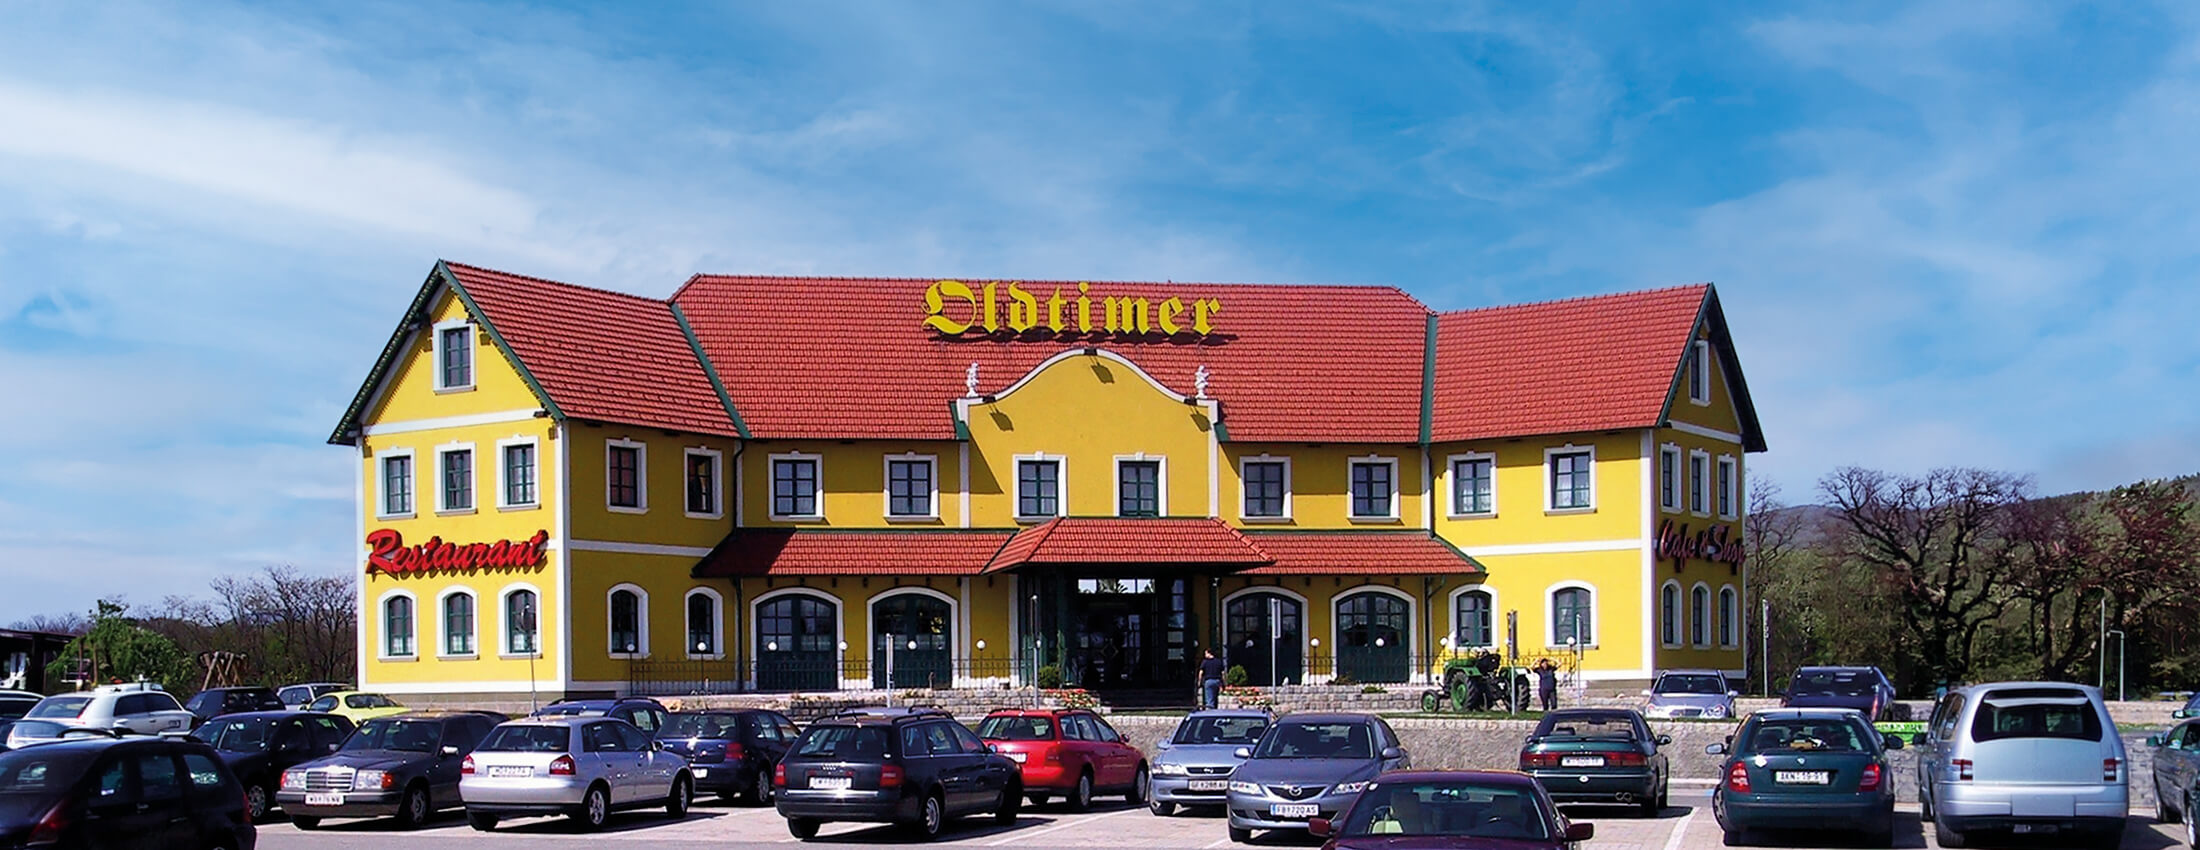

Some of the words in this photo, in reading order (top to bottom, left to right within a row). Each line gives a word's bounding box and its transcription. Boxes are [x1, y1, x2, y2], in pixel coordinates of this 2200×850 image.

[921, 280, 1221, 335] Oldtimer
[366, 529, 549, 573] Restaurant
[1709, 523, 1745, 575] Shop
